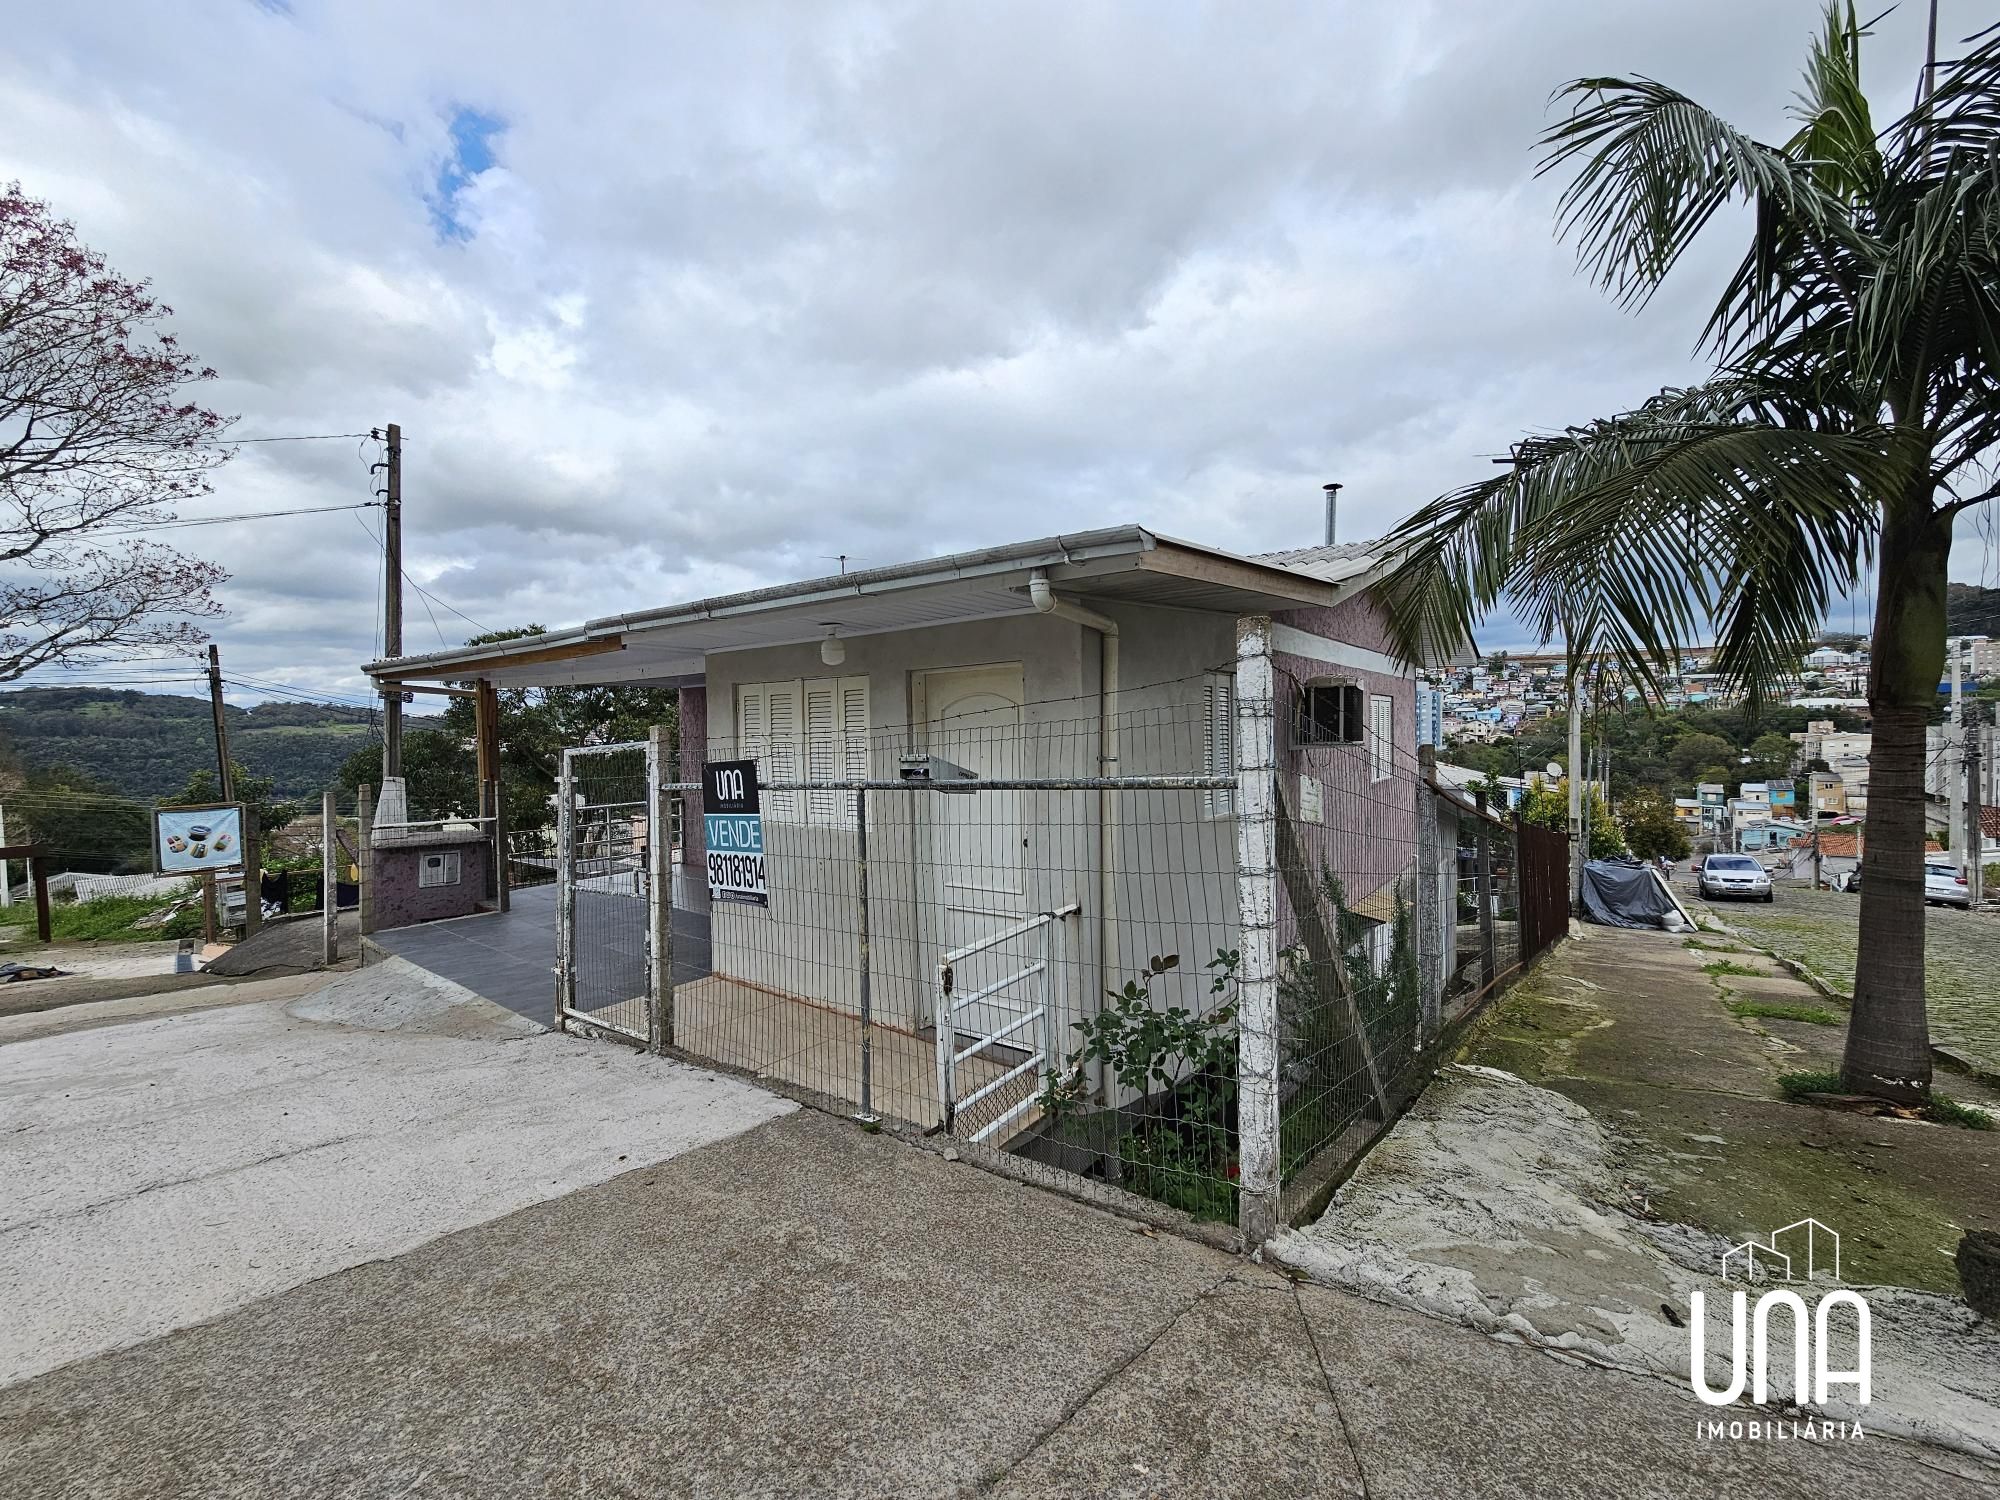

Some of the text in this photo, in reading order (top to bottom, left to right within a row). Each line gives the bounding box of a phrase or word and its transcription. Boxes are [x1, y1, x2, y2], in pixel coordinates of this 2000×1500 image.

[715, 769, 744, 800] UNA
[709, 820, 761, 848] VENDE
[708, 853, 766, 890] 981181914
